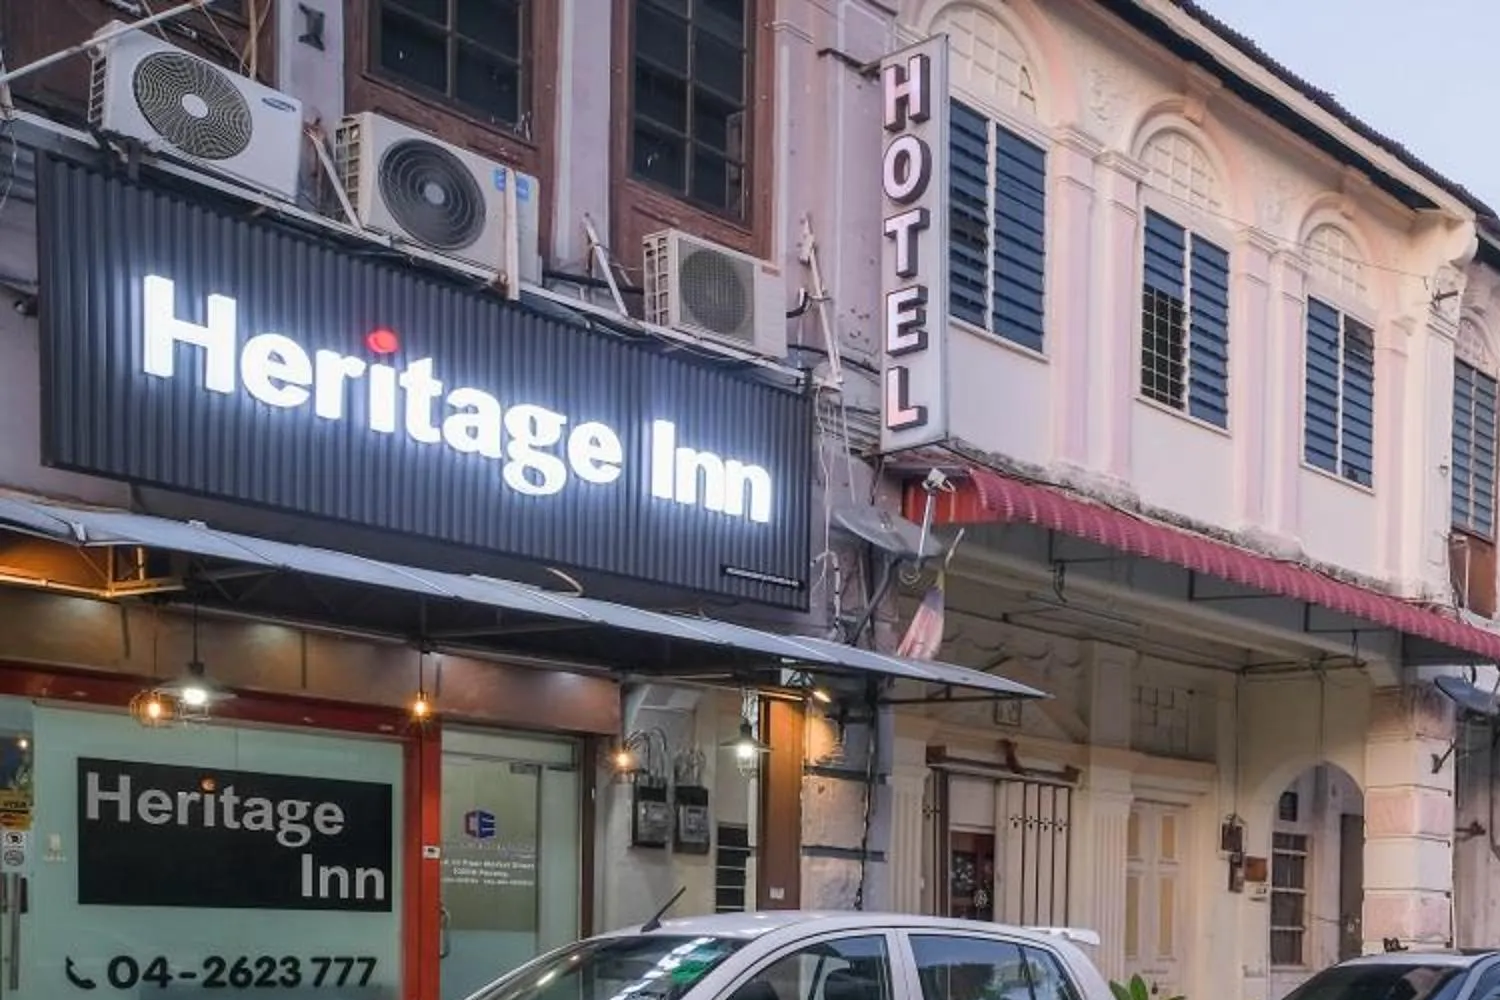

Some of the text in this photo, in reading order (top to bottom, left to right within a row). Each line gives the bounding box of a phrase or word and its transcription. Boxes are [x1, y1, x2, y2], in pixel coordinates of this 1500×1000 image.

[880, 53, 932, 431] HOTEL
[143, 274, 772, 523] Heritage Inn
[86, 771, 345, 848] Heritage
[301, 853, 386, 900] Inn
